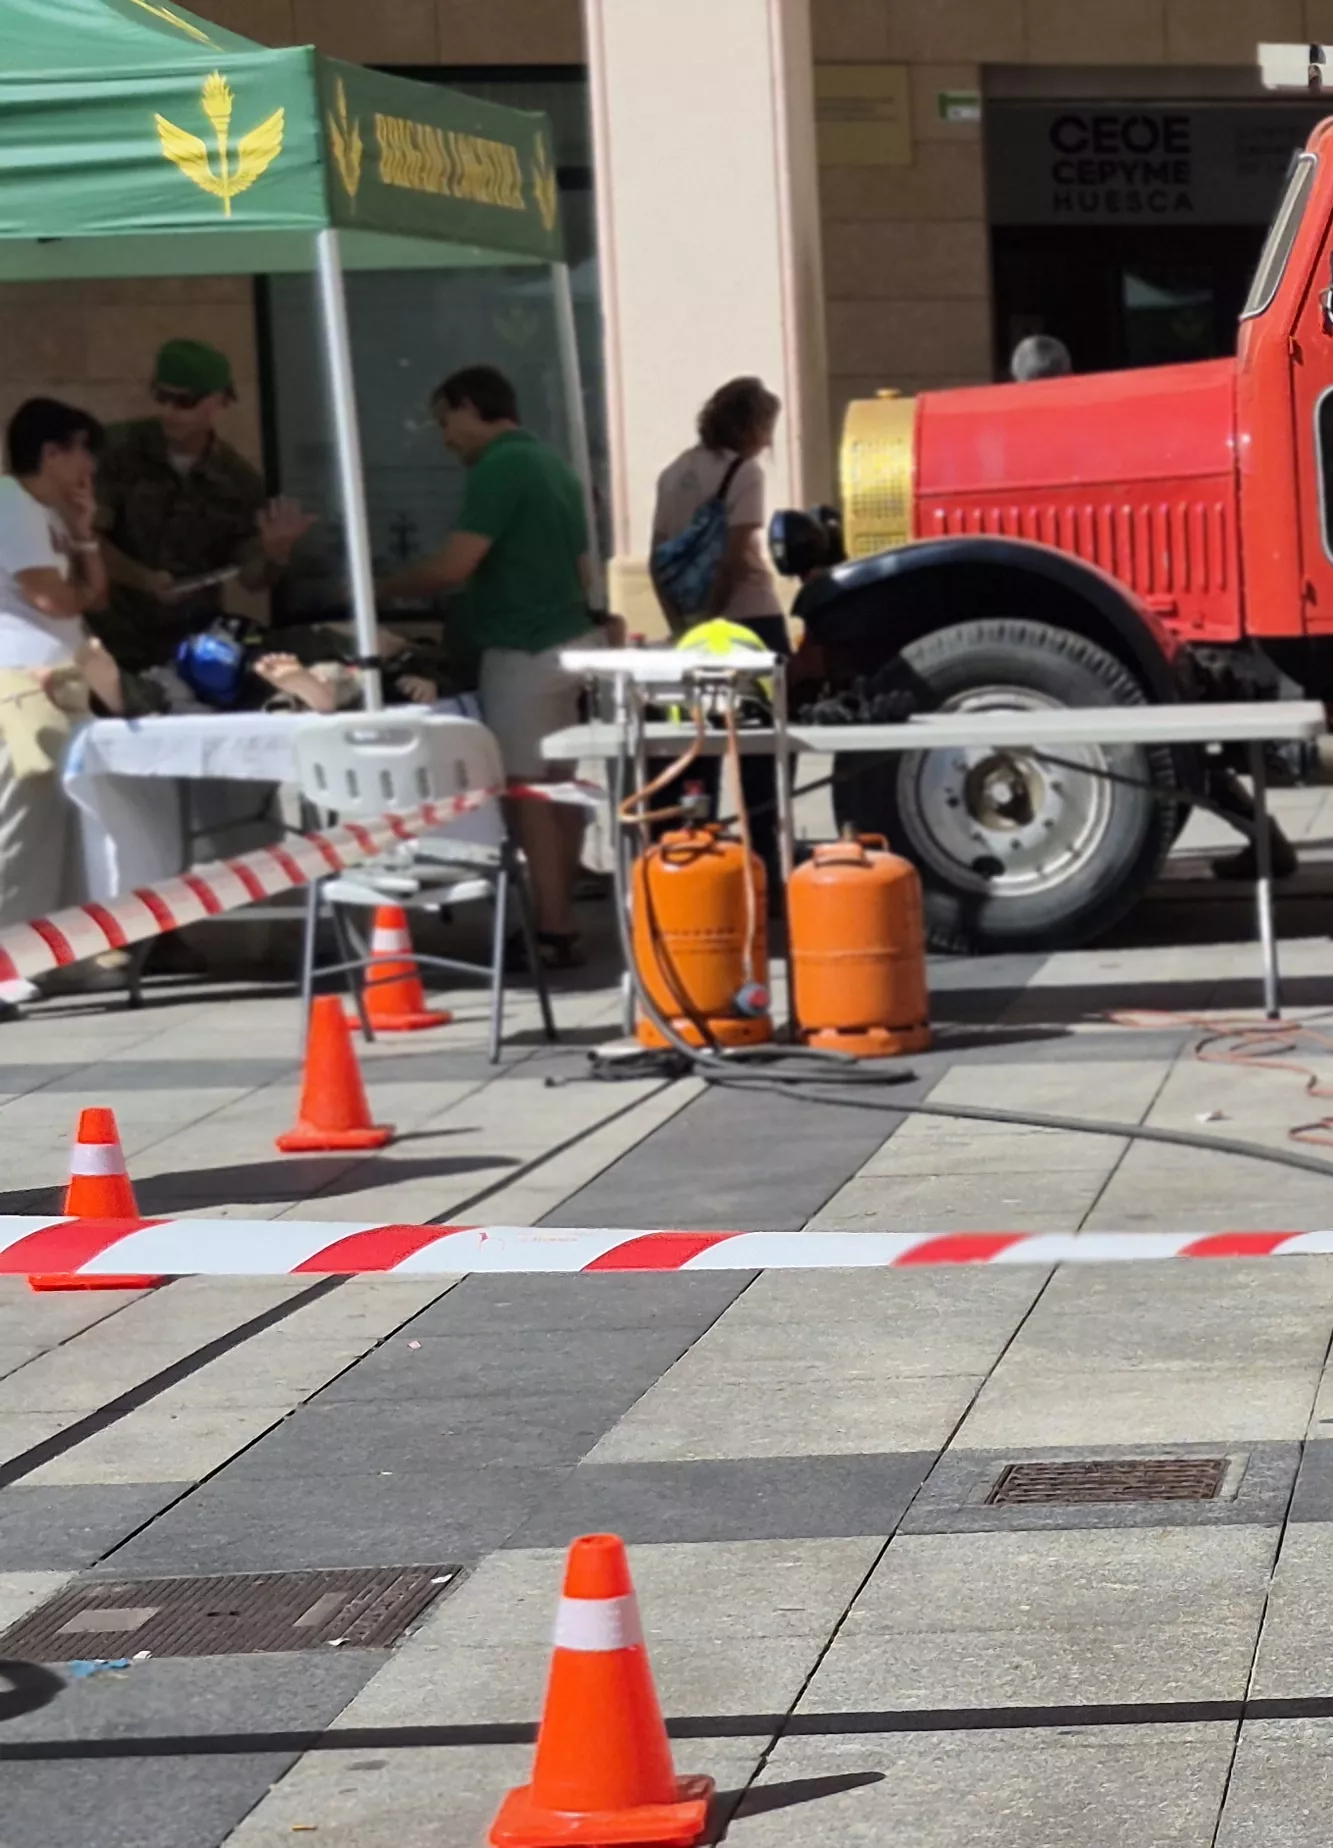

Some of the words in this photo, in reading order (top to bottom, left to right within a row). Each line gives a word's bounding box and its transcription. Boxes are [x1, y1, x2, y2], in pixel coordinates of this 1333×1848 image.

[1049, 115, 1191, 154] CEOE
[1052, 160, 1191, 186] CEPYME
[1053, 190, 1194, 213] HUESCA
